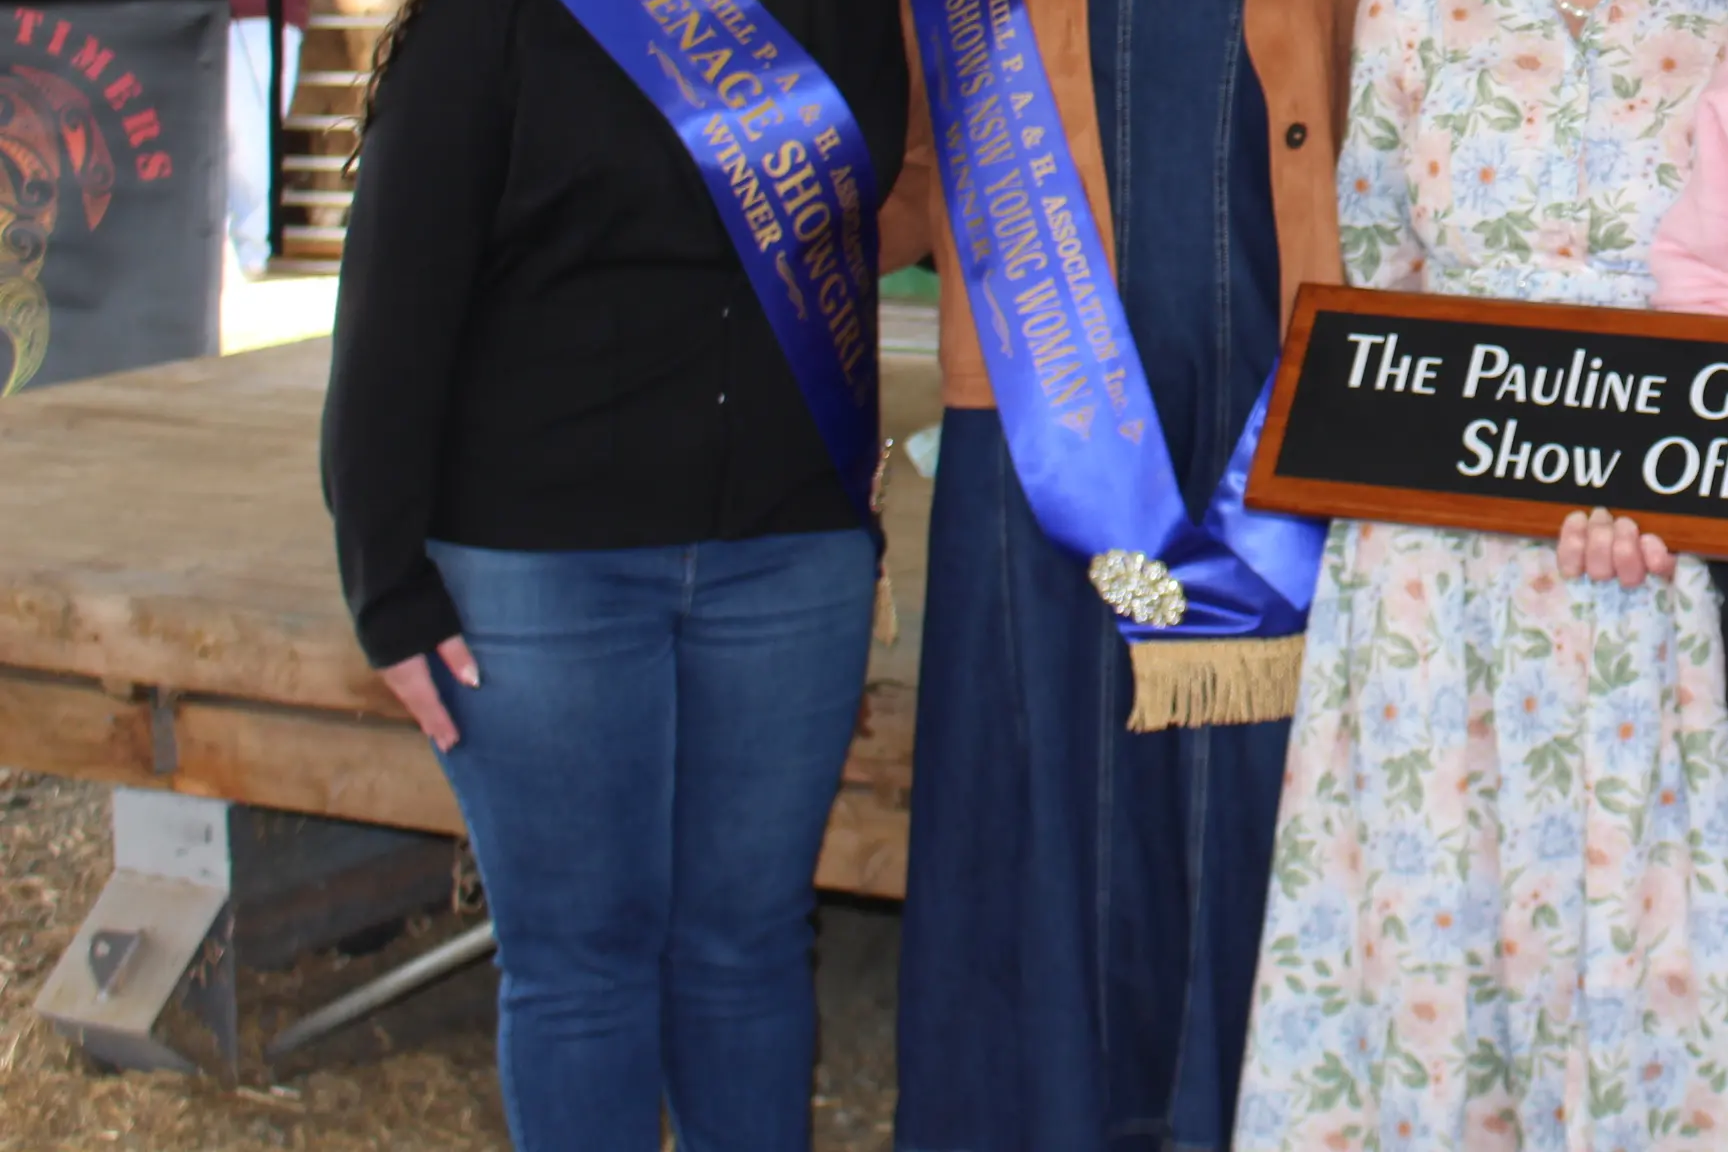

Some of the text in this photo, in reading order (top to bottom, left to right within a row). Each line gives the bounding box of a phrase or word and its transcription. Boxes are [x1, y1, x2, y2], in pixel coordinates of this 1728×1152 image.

[13, 6, 174, 182] TIMERS
[751, 43, 779, 70] P.
[698, 111, 784, 255] WINNER
[945, 120, 994, 265] WINNER
[963, 94, 1017, 167] NSW
[1021, 125, 1046, 150] &
[1030, 152, 1058, 187] H.
[762, 139, 866, 386] SHOWGIRL
[983, 167, 1049, 282] YOUNG
[1041, 194, 1120, 363] ASSOCIATION
[1012, 276, 1094, 410] WOMAN
